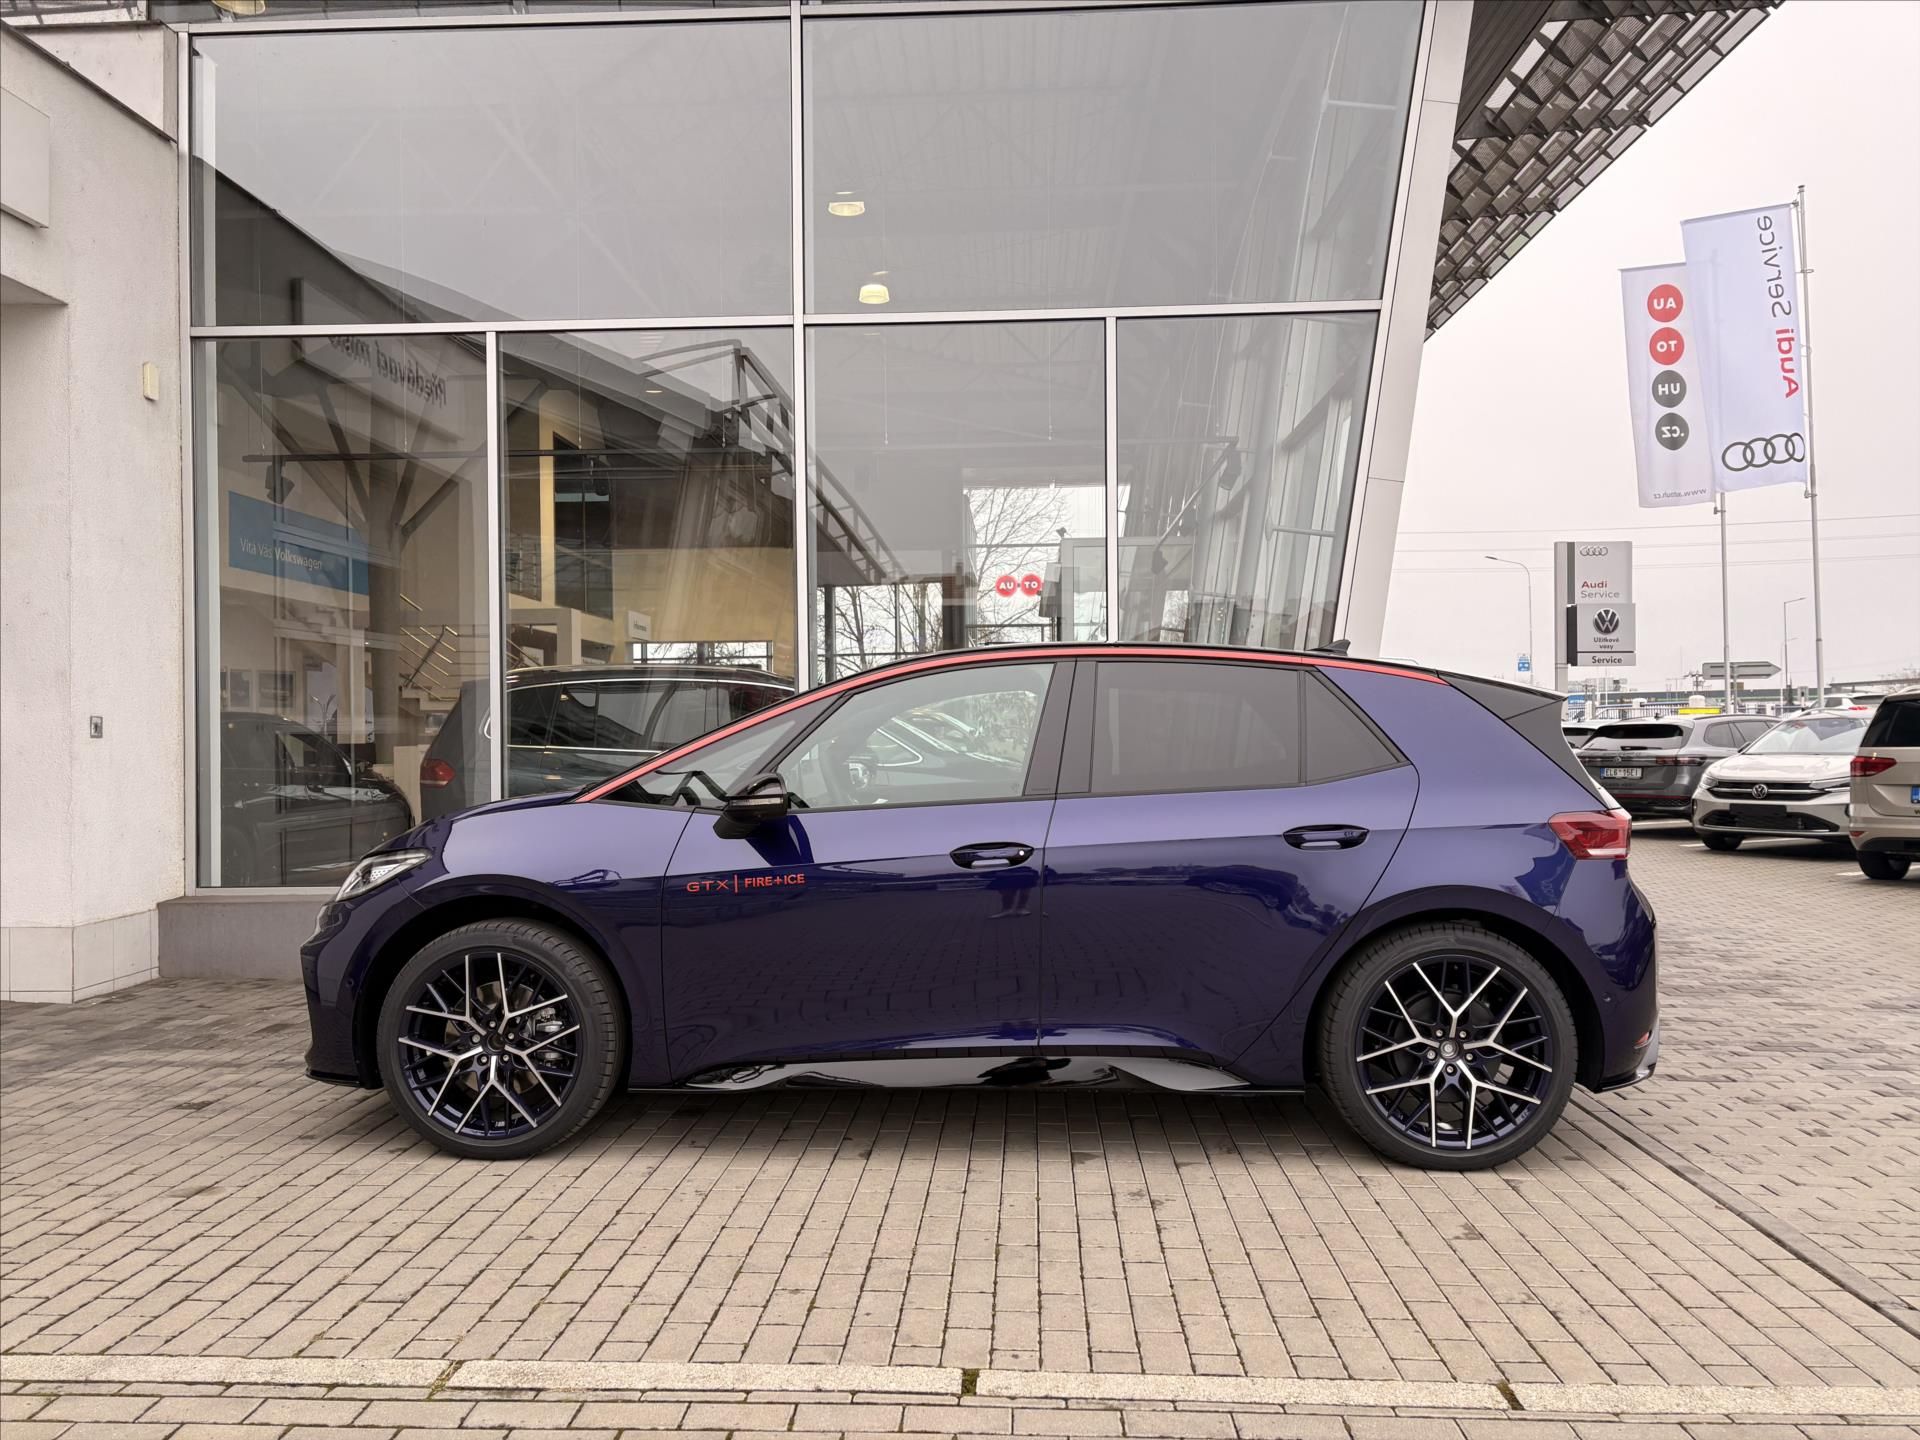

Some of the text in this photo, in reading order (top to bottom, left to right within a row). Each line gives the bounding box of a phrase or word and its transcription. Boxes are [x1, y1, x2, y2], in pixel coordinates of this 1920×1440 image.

[275, 547, 321, 571] Volkswagen
[1592, 655, 1622, 664] Service
[686, 873, 805, 892] GTX FIRE+ICE
